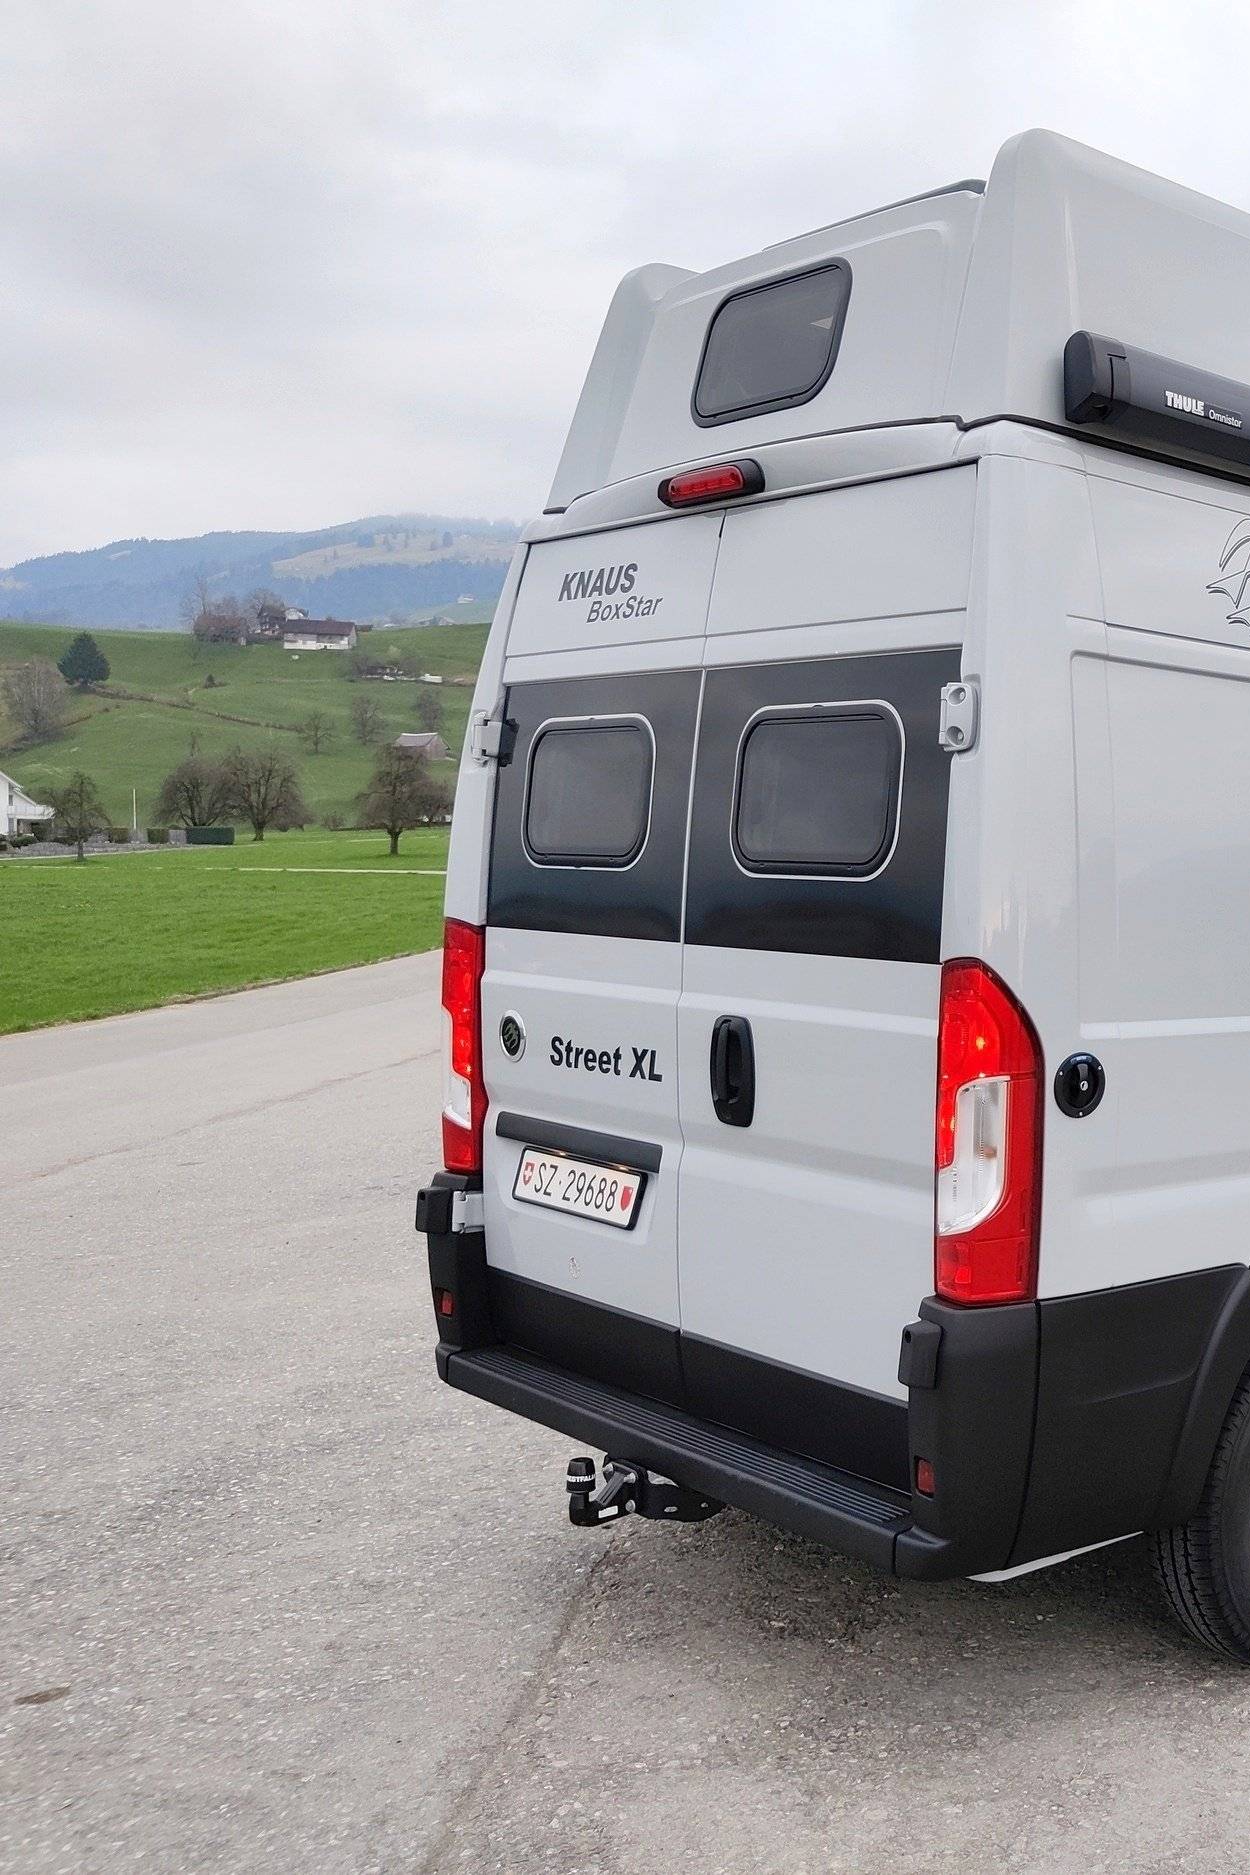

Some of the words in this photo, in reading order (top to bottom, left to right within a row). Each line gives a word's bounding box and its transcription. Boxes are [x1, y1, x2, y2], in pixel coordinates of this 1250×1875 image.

[1165, 390, 1205, 416] THULE
[1208, 409, 1242, 428] Omnistor
[558, 563, 638, 601] KNAUS
[586, 595, 664, 623] BoxStar
[550, 1036, 622, 1075] Street
[628, 1046, 663, 1082] XL
